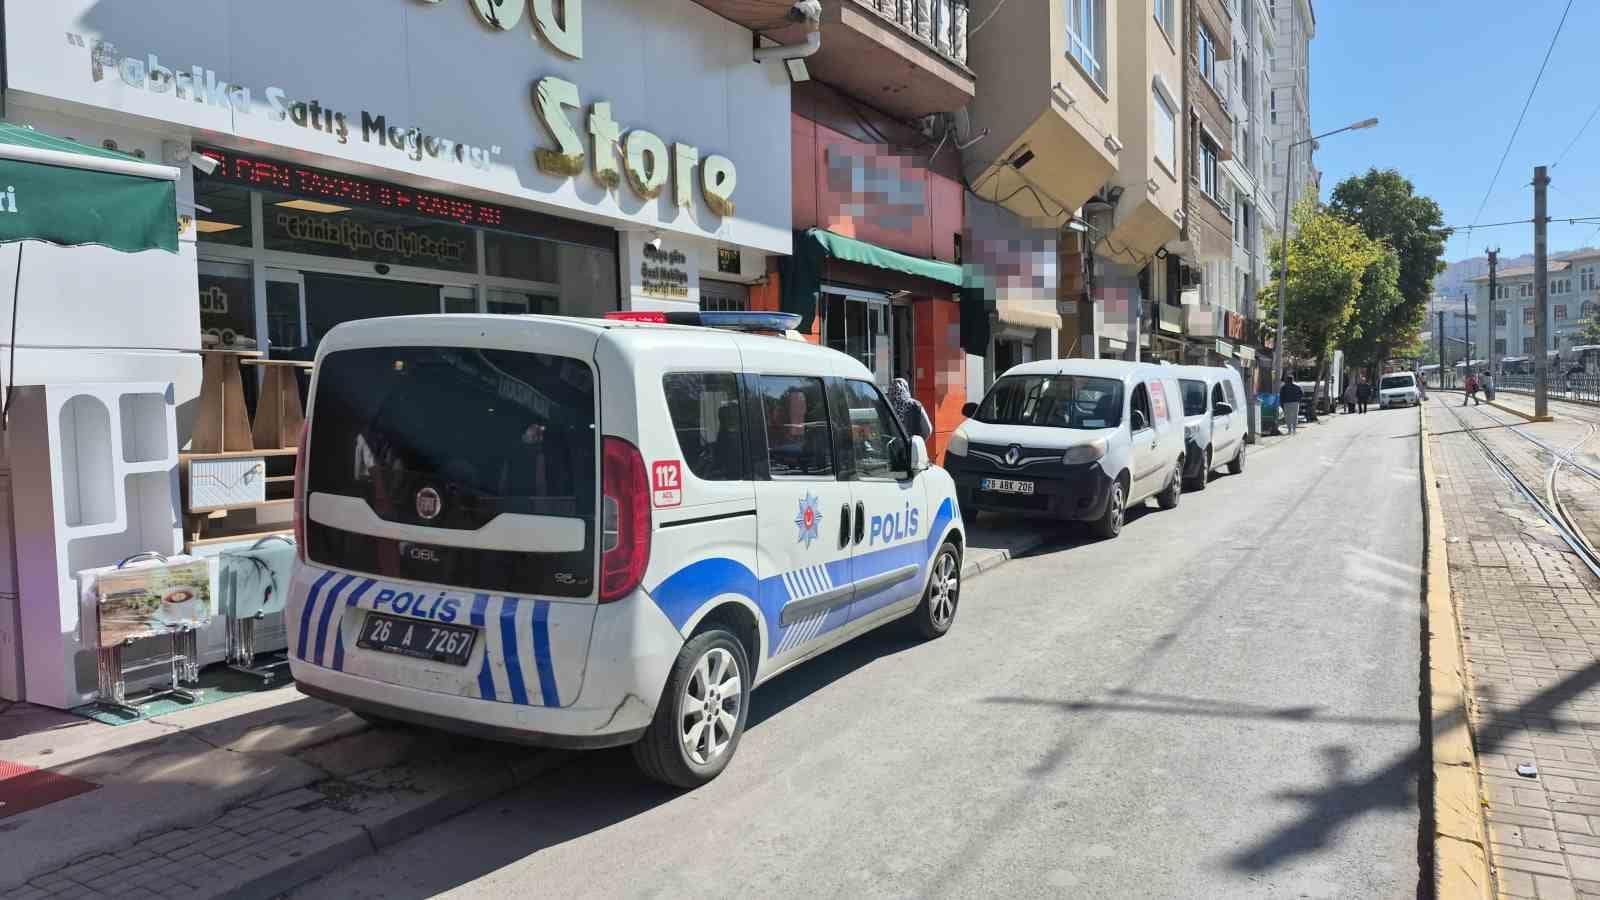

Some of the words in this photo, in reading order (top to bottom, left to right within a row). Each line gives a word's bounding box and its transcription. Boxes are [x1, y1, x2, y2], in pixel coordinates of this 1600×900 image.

[264, 86, 348, 144] Satış
[531, 76, 737, 216] Store
[656, 465, 678, 487] 112
[870, 502, 919, 546] POLİS
[373, 589, 461, 623] POLİS
[370, 620, 393, 642] 26
[401, 625, 415, 647] A
[426, 628, 471, 656] 7267
